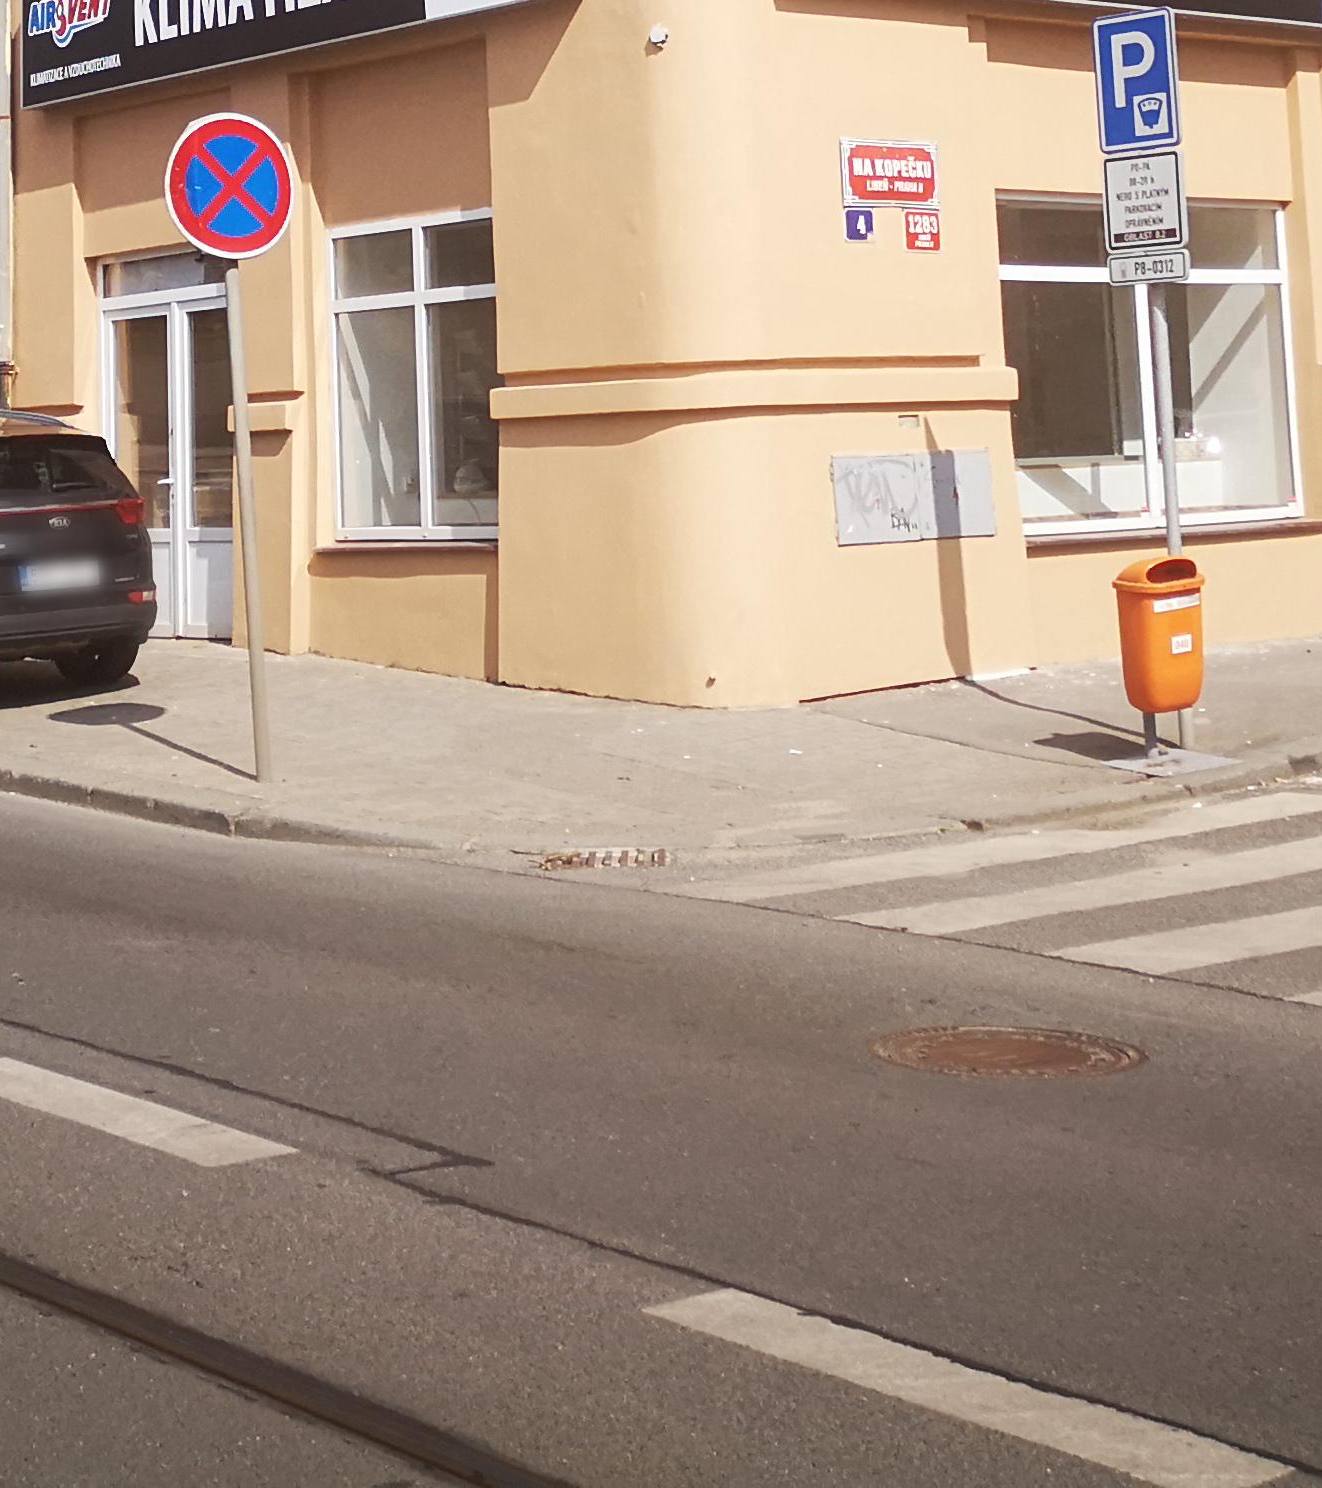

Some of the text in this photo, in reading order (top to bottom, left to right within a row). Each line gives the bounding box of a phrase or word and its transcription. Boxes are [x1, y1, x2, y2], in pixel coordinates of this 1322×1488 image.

[29, 2, 57, 36] AIR
[1111, 31, 1156, 109] P
[852, 155, 932, 179] NA KOPEČKU
[857, 215, 866, 234] 4
[908, 214, 938, 234] 1283
[1134, 258, 1174, 275] P8-0312
